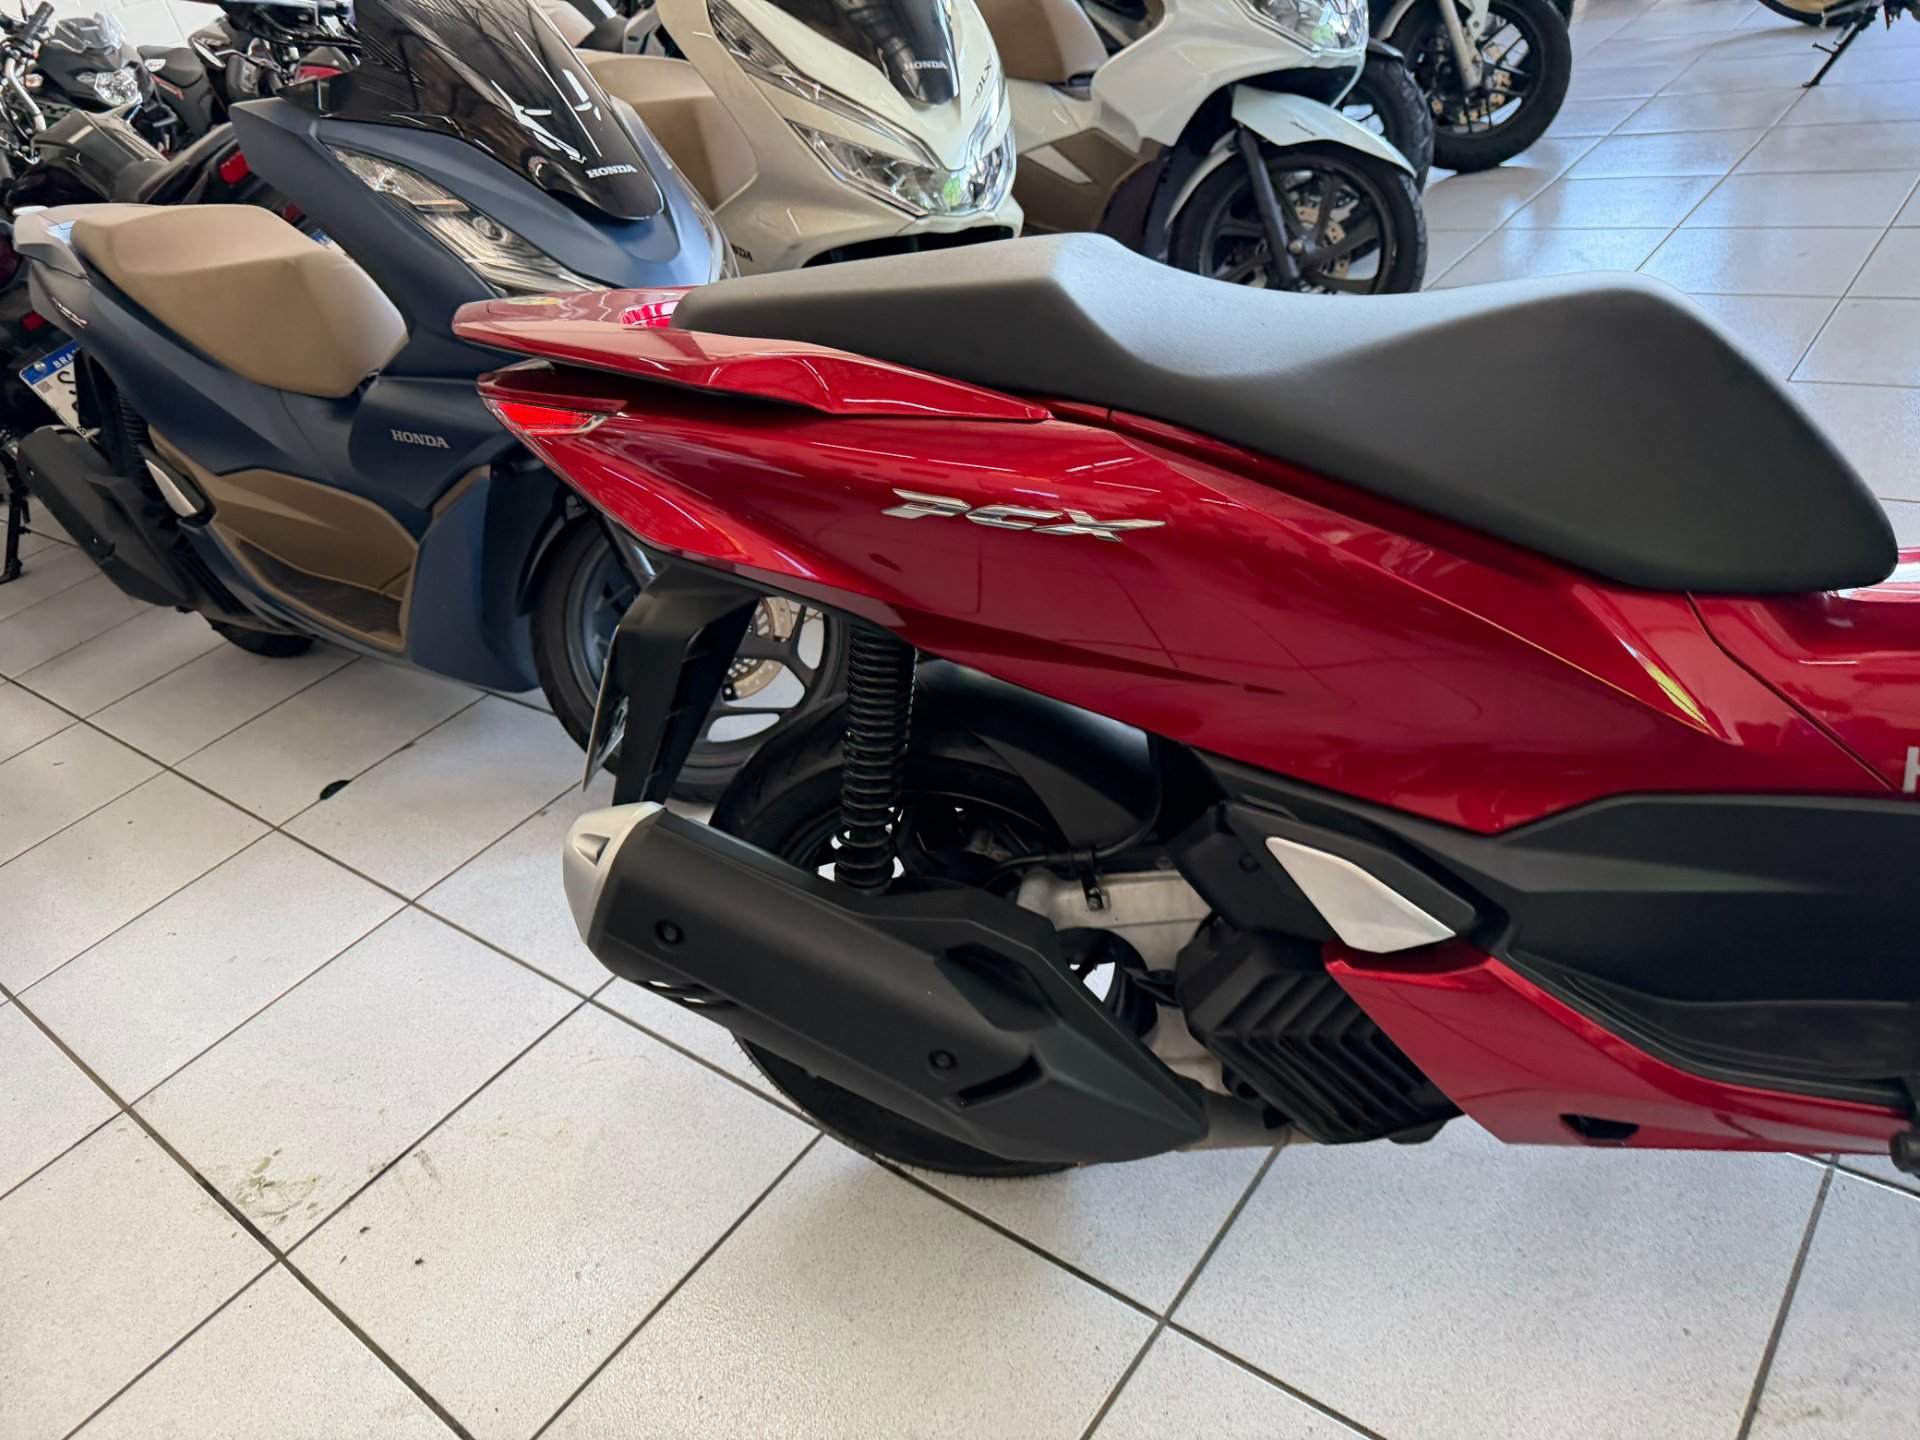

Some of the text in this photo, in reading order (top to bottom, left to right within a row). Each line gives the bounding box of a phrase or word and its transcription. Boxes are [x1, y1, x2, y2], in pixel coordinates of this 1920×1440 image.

[903, 60, 948, 70] HONDA
[585, 164, 639, 179] HONDA
[731, 243, 754, 262] NDA
[52, 350, 76, 369] BRA
[390, 429, 451, 449] HONDA
[881, 487, 1166, 543] PCX
